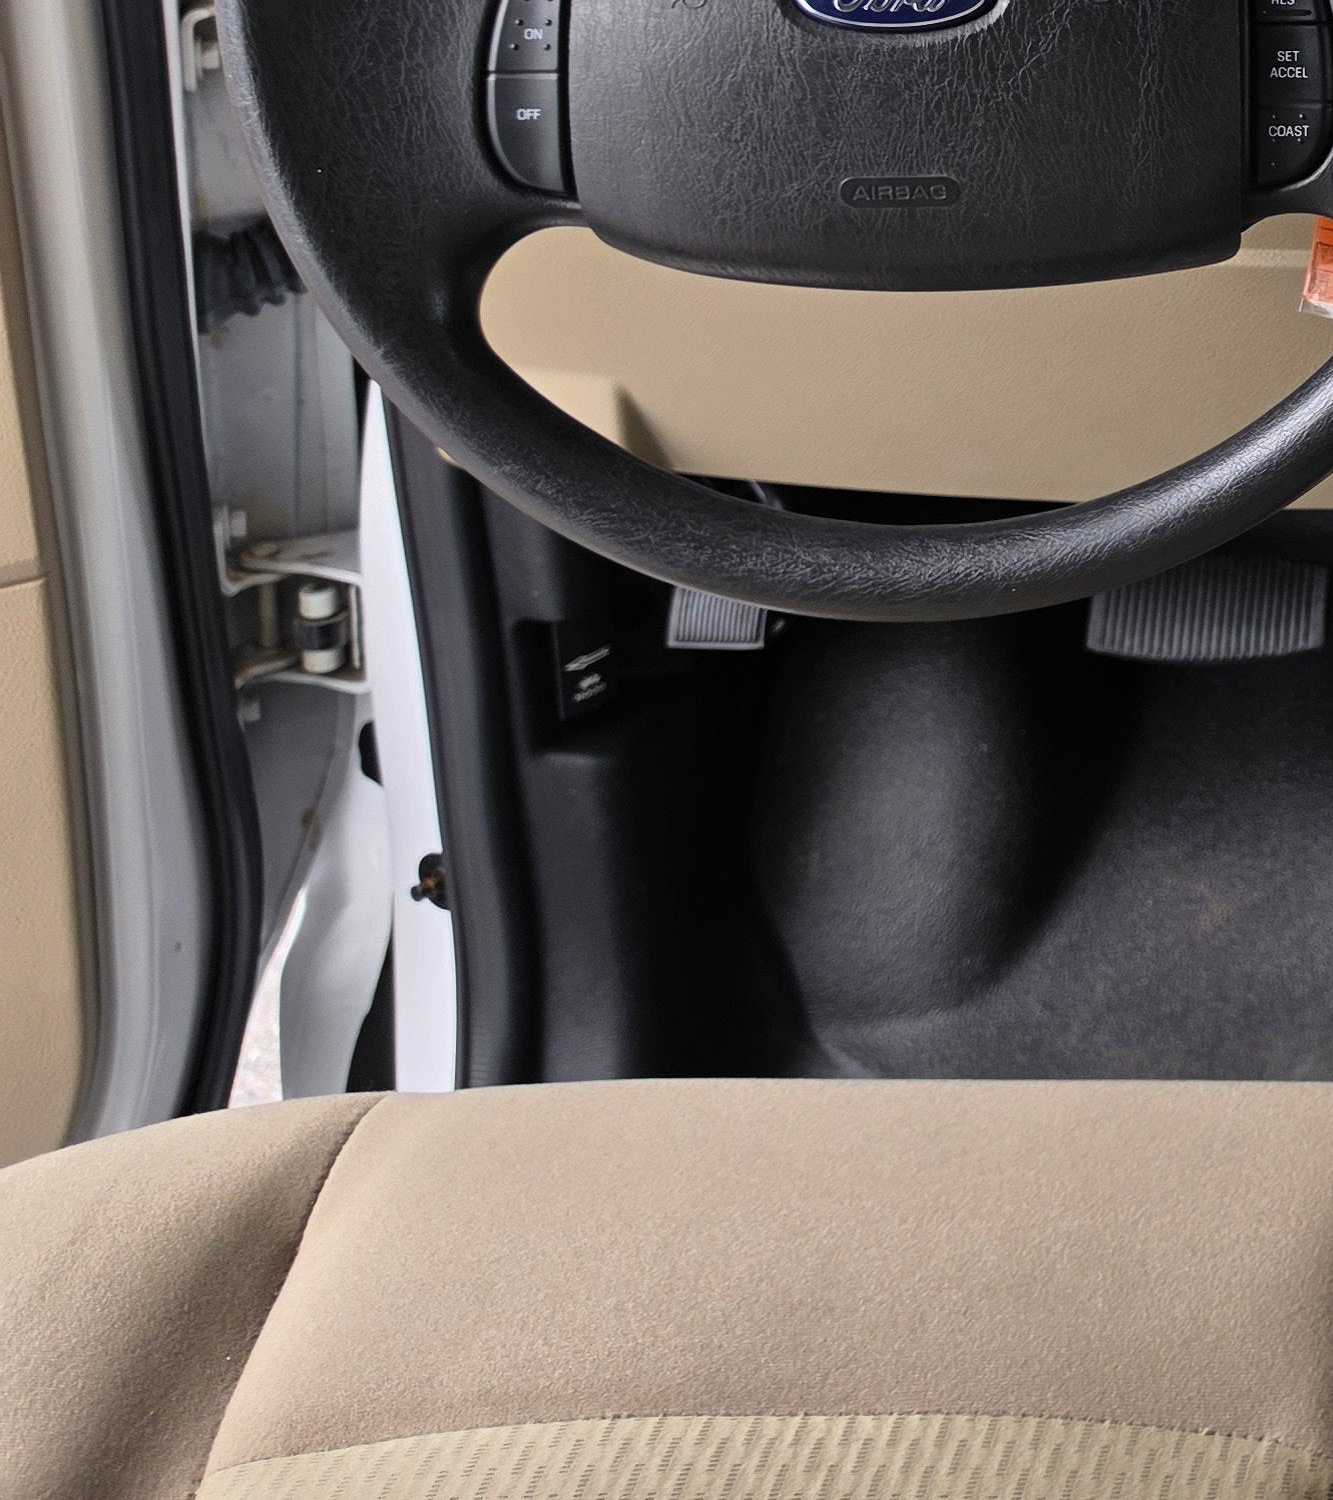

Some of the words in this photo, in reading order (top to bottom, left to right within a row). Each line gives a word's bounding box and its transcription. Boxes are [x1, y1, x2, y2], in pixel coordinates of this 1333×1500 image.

[523, 28, 543, 40] ON
[1276, 50, 1299, 63] SET
[1269, 66, 1309, 80] ACCEL
[516, 108, 541, 121] OFF
[1268, 125, 1310, 138] COAST
[851, 184, 948, 202] AIRBAG
